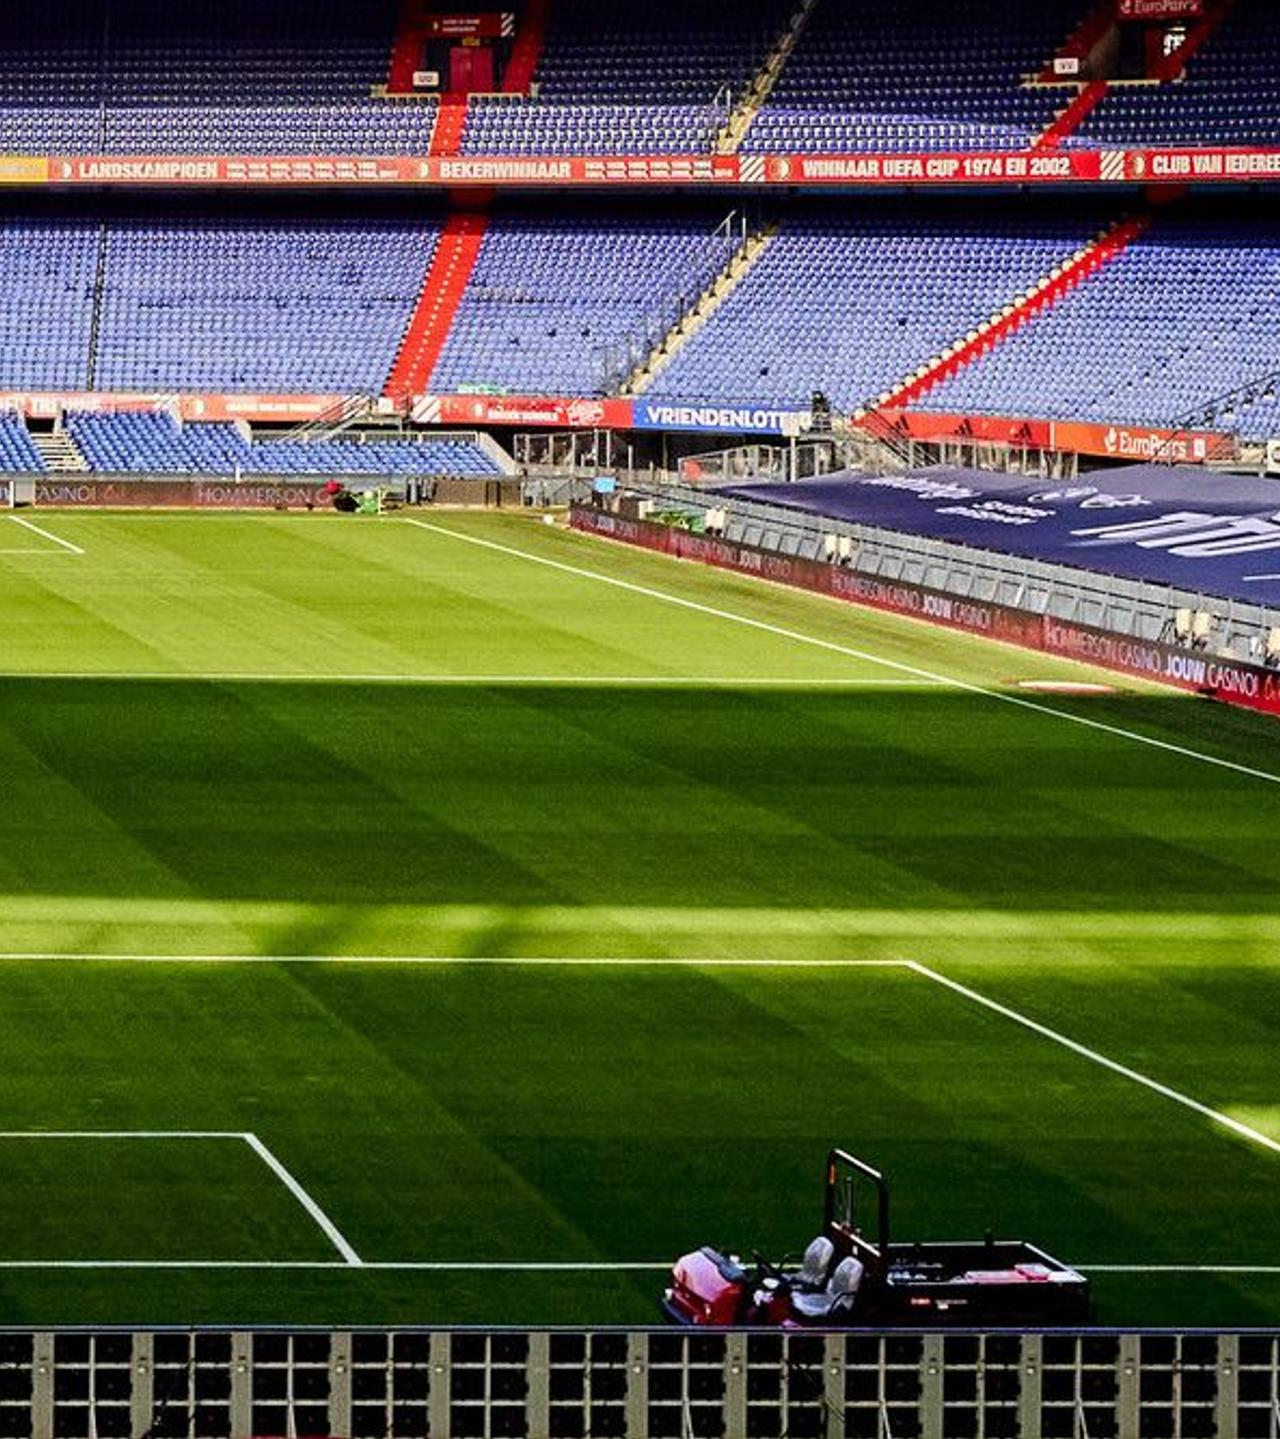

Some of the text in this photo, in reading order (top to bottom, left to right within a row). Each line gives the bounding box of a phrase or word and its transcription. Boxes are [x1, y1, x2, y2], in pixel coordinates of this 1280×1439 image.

[79, 162, 217, 179] LANDSKAMPIOEN
[441, 161, 571, 178] BEKERWINNAAR
[803, 157, 1071, 177] WINNAAR UEFA CUP 1974 EN 2002
[1152, 155, 1190, 174] CLUB
[1192, 155, 1223, 174] VAN
[923, 594, 952, 620] JOUW
[1045, 624, 1117, 662] HOMMERSON
[1165, 654, 1206, 683] JOUW
[1207, 663, 1259, 698] CASINO!
